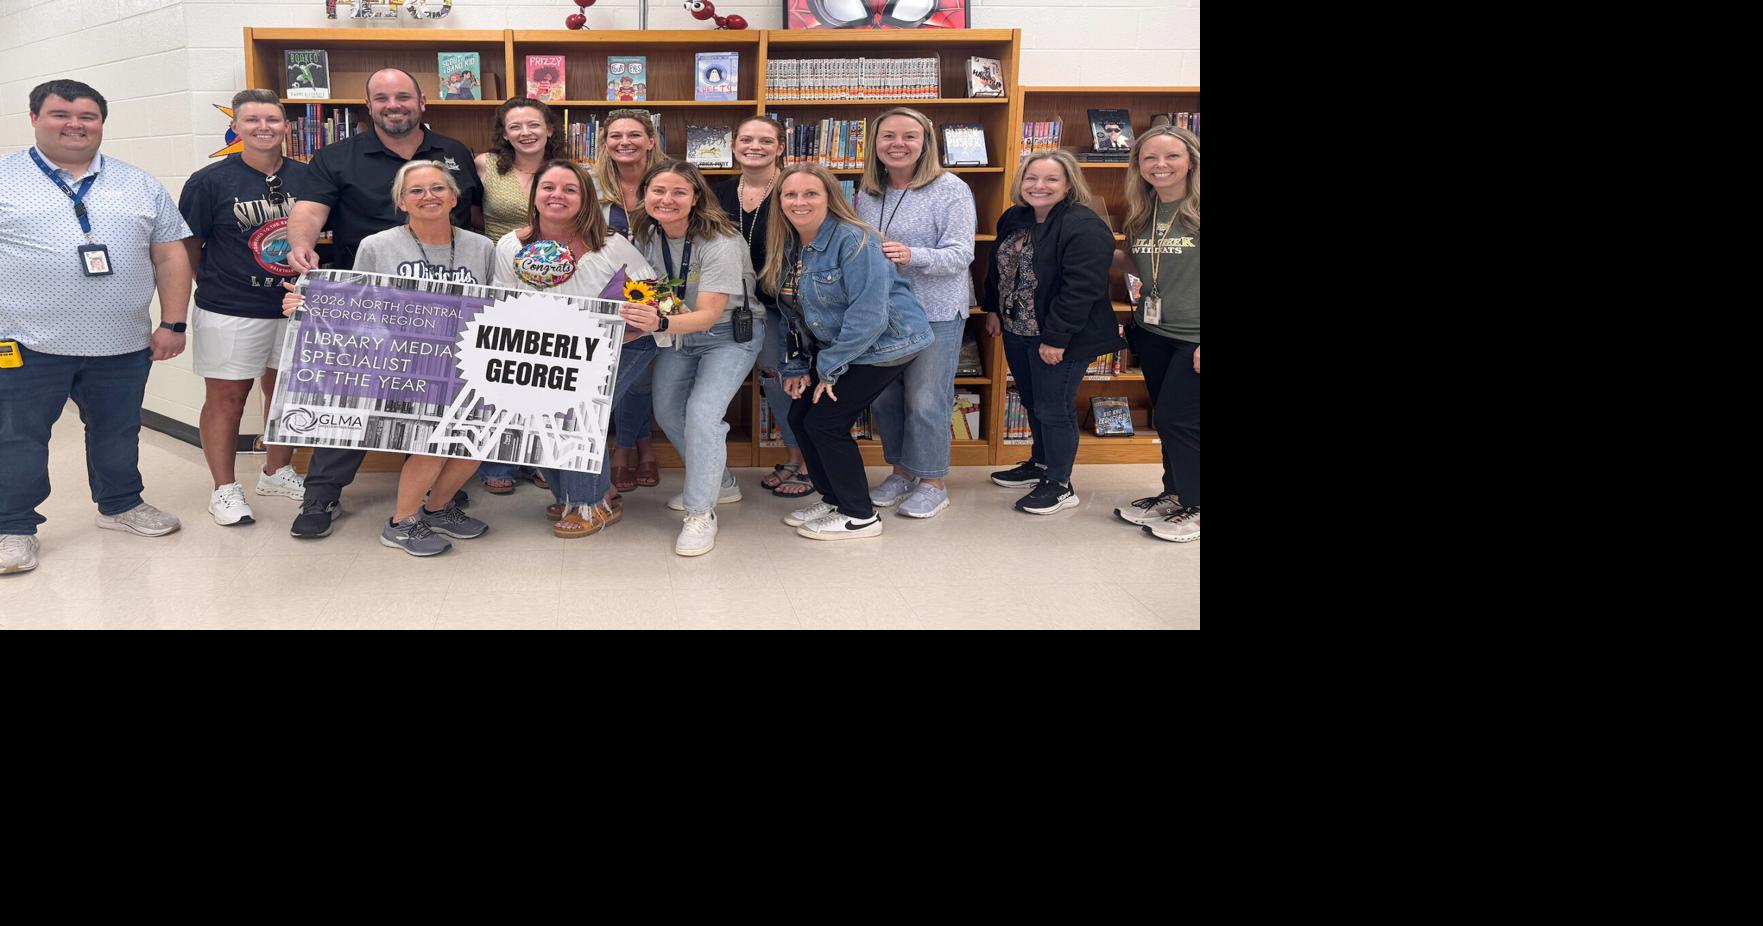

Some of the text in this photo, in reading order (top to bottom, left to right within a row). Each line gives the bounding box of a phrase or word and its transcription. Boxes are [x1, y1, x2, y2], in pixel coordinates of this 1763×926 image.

[290, 53, 319, 63] BOOKED
[522, 258, 571, 276] Congrats
[309, 307, 436, 329] GEORGIA REGION
[312, 294, 464, 320] 2026 NORTH CENTRAL
[304, 330, 455, 358] LIBRARY MEDIA
[475, 325, 600, 362] KIMBERLY
[300, 350, 412, 373] SPECIALIST
[297, 369, 427, 393] OF THE YEAR
[485, 358, 579, 392] GEORGE
[319, 414, 362, 427] GLMA
